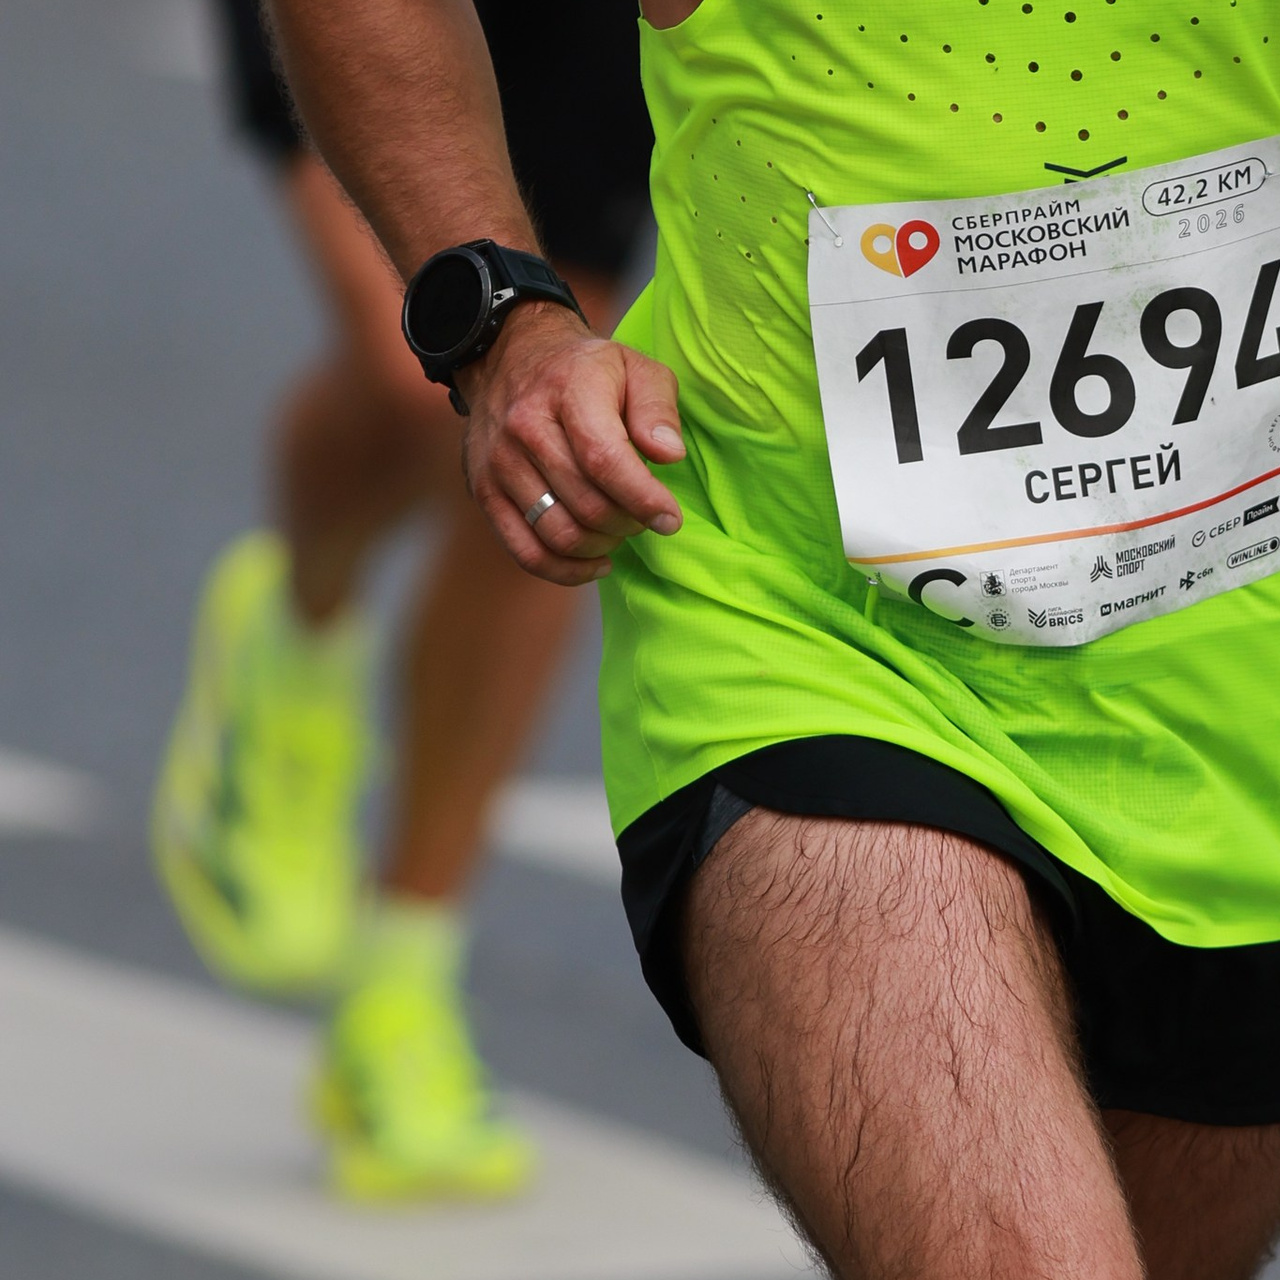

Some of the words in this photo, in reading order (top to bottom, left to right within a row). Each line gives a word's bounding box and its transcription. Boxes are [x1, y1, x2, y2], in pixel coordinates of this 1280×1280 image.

[1158, 179, 1208, 206] 42,2
[1219, 166, 1251, 193] КМ
[952, 200, 1080, 230] СБЕРПРАЙМ
[954, 207, 1130, 252] МОСКОВСКИЙ
[1178, 203, 1245, 238] 2026
[957, 240, 1087, 274] МАРАФОН
[1024, 442, 1182, 504] СЕРГЕЙ
[1209, 516, 1241, 538] СБЕР
[1247, 503, 1273, 520] Прайм
[1116, 534, 1176, 564] МОСКОВСКИЙ
[1231, 543, 1269, 565] WINLINE
[1009, 564, 1058, 576] Департамент
[1010, 576, 1037, 586] спорта
[1116, 559, 1145, 577] СПОРТ
[1011, 585, 1038, 594] города
[1040, 580, 1069, 590] Москвы
[1048, 613, 1084, 627] BRICS
